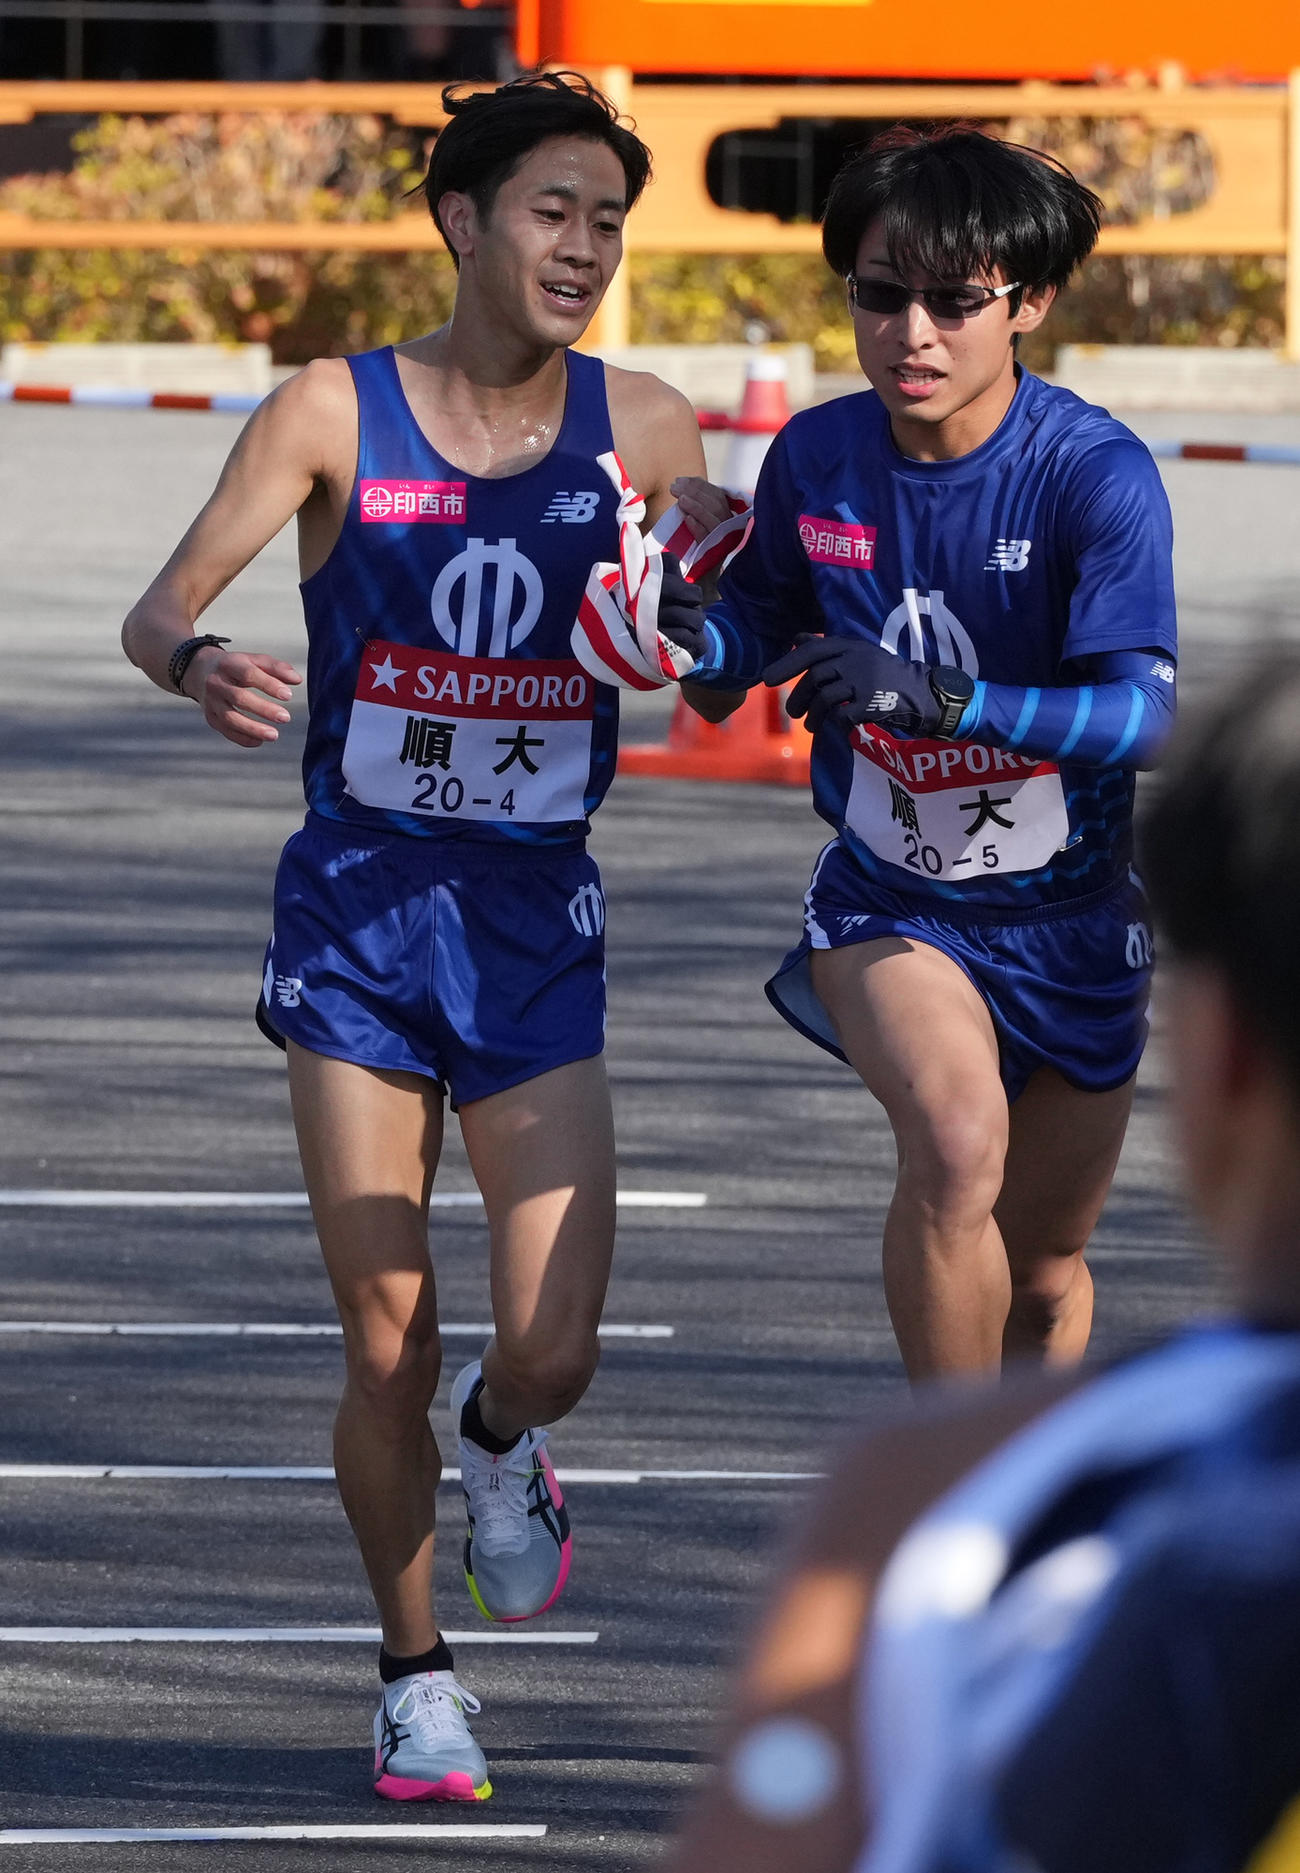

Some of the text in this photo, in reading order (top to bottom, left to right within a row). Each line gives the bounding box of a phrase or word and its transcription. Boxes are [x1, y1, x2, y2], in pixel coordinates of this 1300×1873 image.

[394, 491, 464, 516] 印西市
[816, 531, 874, 561] 印西市
[413, 665, 586, 708] SAPPORO
